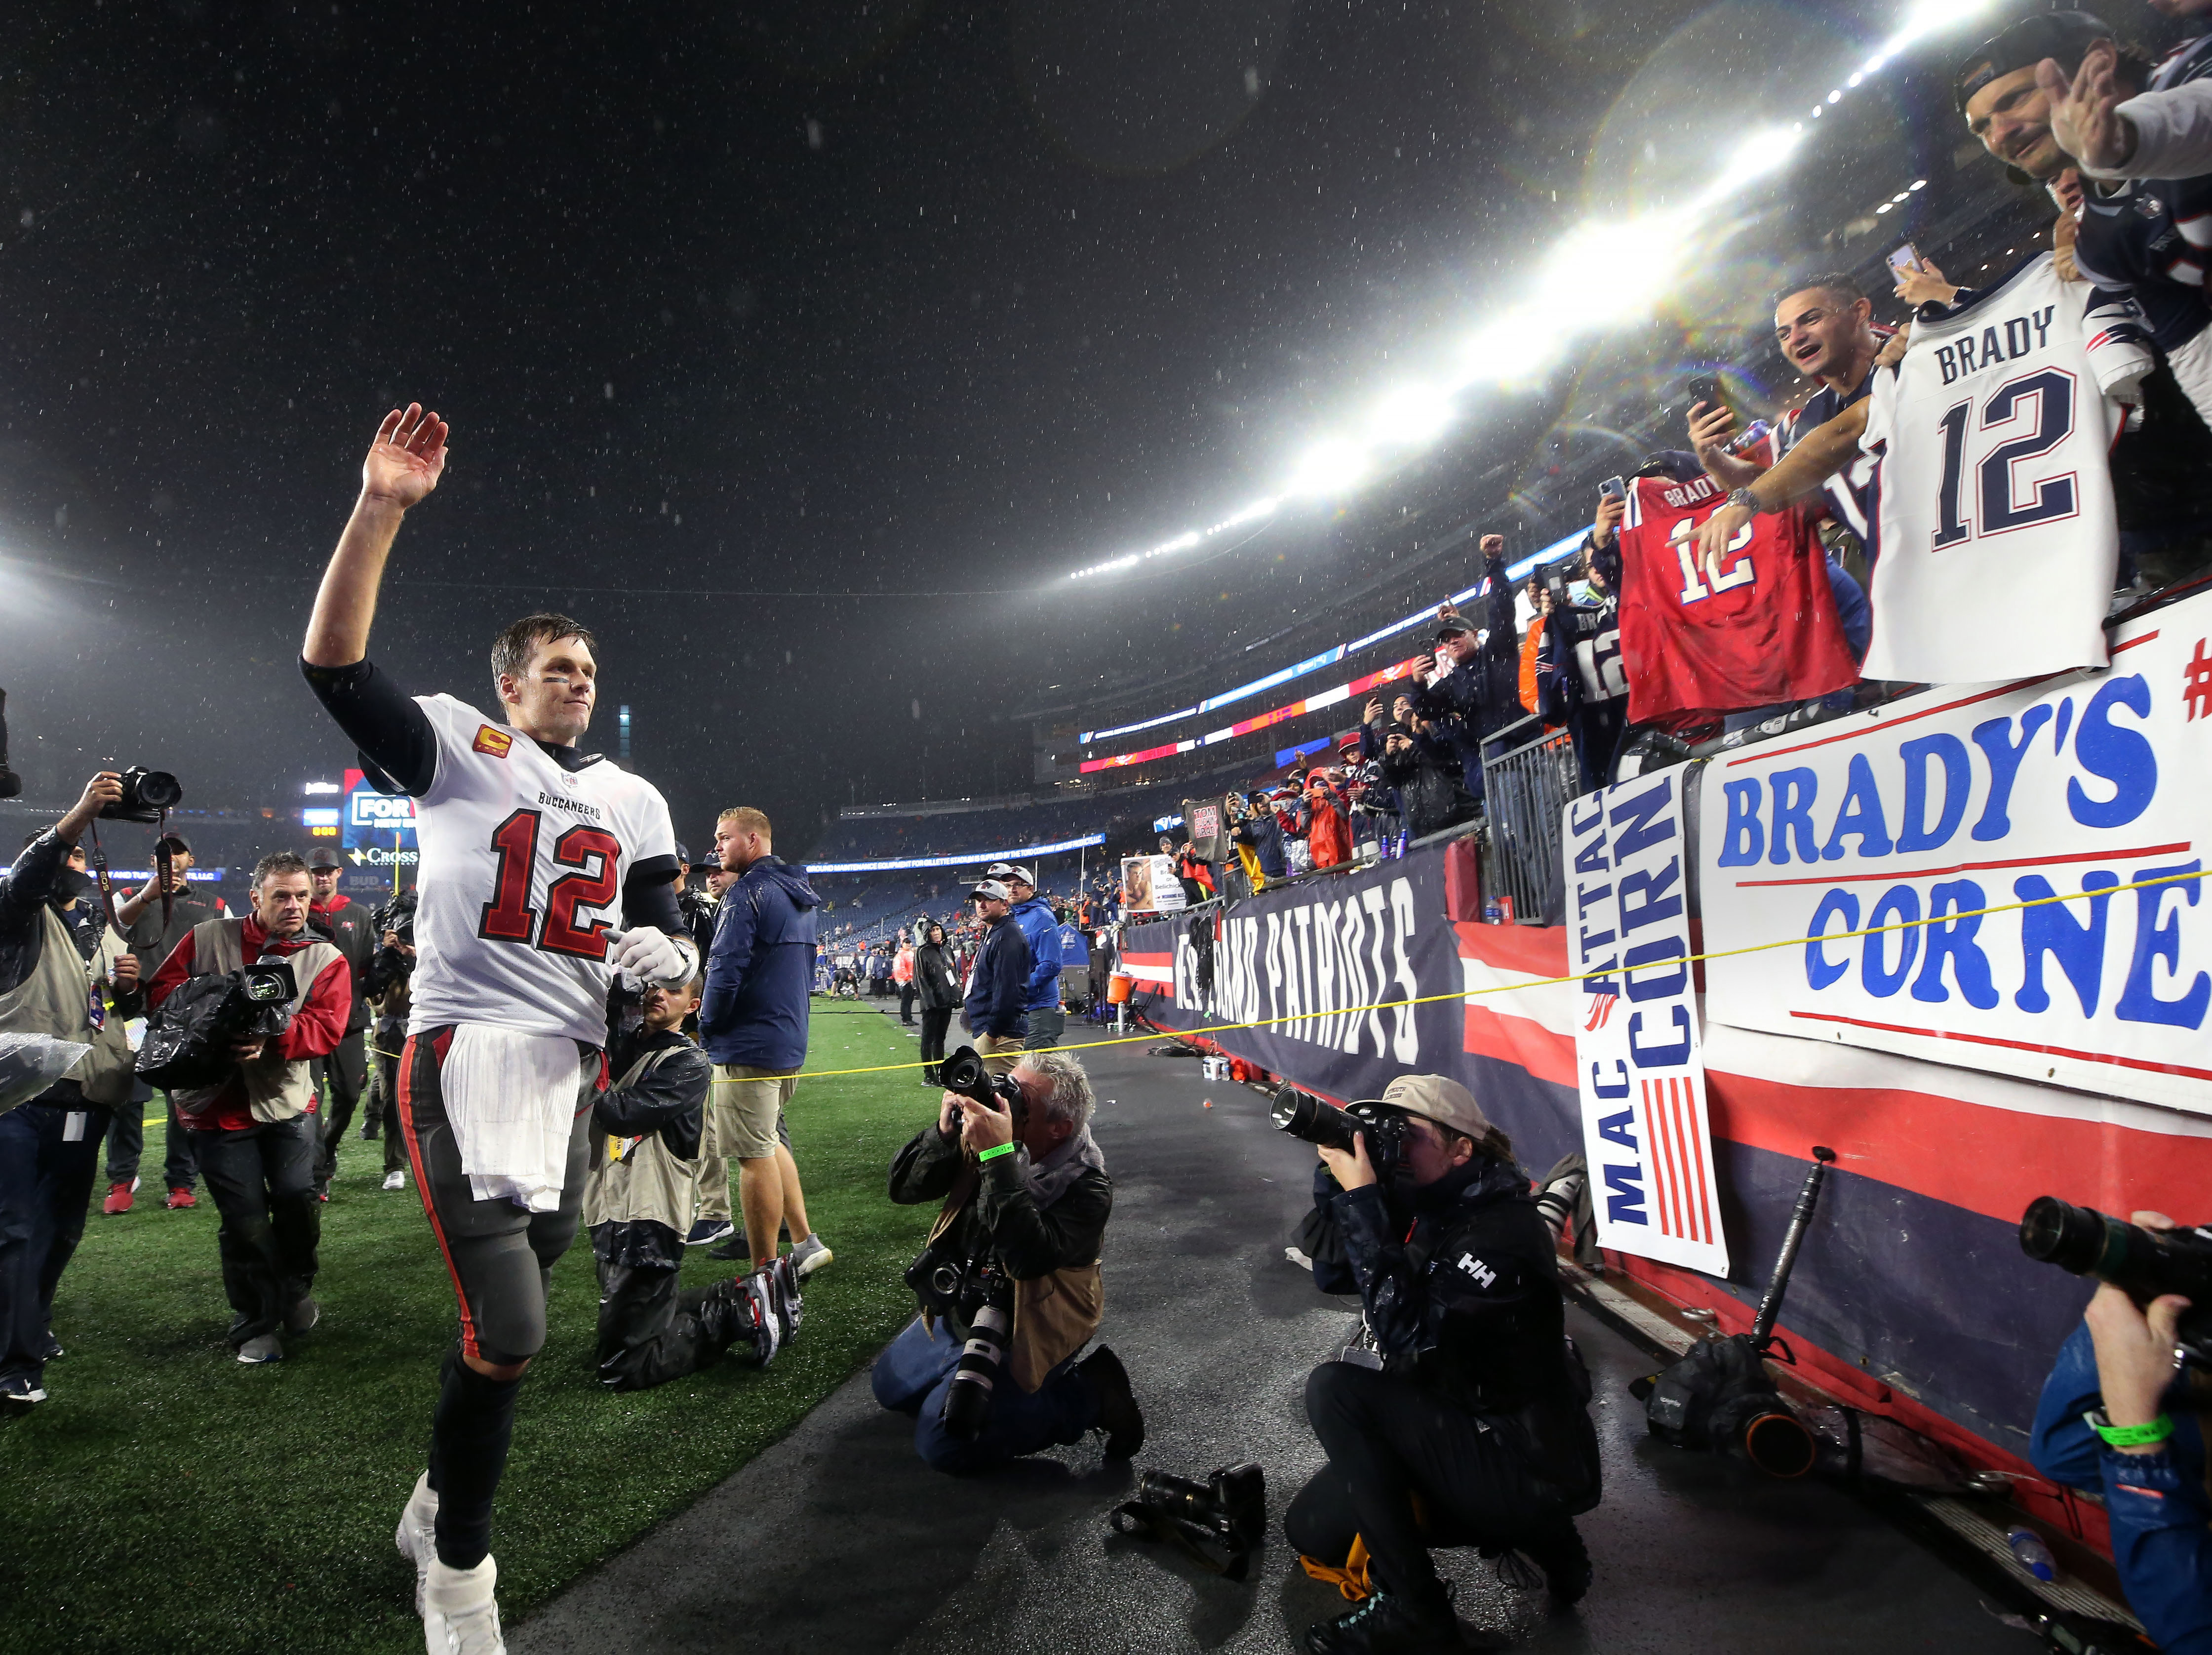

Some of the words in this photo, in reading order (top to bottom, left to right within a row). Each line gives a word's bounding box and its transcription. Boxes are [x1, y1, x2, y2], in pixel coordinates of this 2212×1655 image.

[1934, 304, 2056, 386] BRADY
[1931, 365, 2081, 553] 12
[538, 791, 601, 820] BUCCANEERS
[1717, 673, 2158, 868] BRADY'S
[1195, 807, 1216, 819] TOM
[100, 871, 110, 891] EOS
[199, 872, 214, 880] LLC
[477, 807, 622, 963] 12
[833, 863, 877, 872] MAINTENANCE
[877, 861, 911, 869] EQUIPMENT
[923, 858, 950, 867] GILLETTE
[1265, 877, 1420, 1065] PATRIOTS
[1592, 1059, 1649, 1226] MAC
